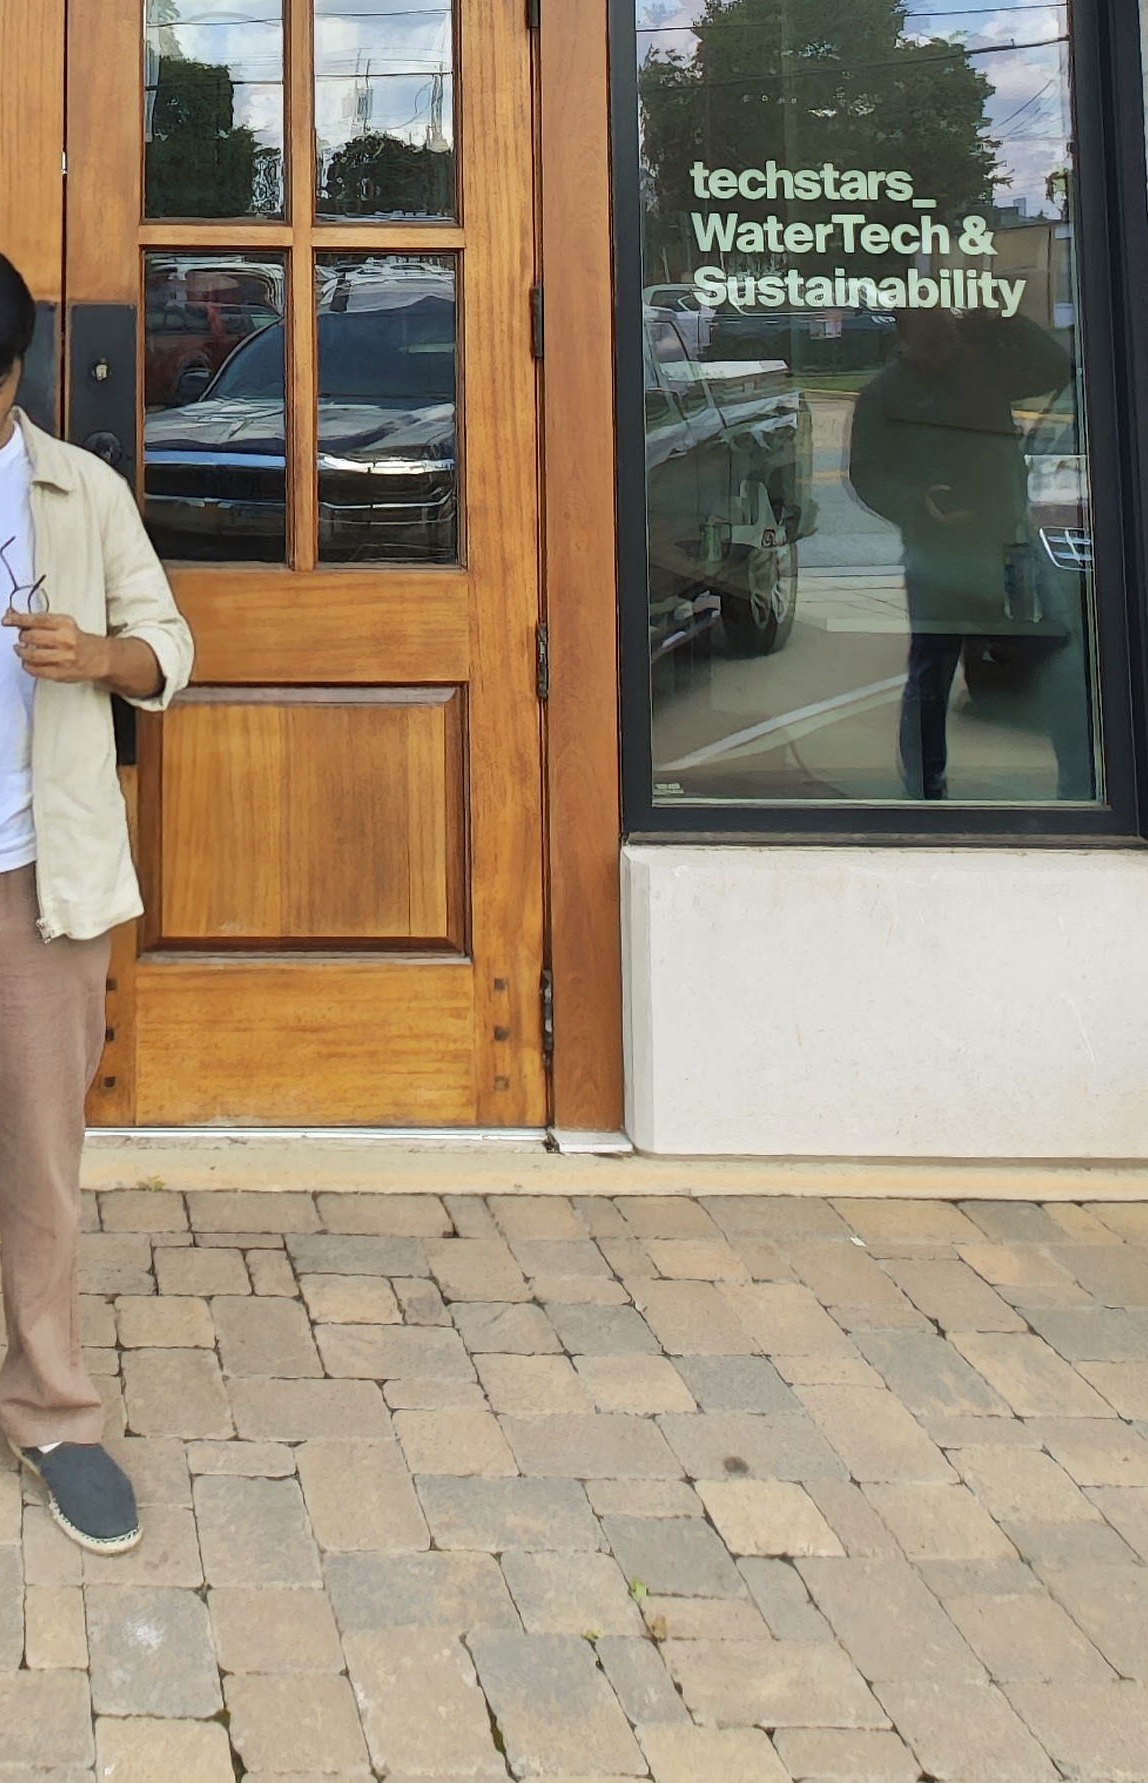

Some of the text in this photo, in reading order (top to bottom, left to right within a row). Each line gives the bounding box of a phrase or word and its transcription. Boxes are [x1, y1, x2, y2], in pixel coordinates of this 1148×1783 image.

[689, 160, 937, 208] techstars_
[690, 212, 999, 256] WaterTech &
[692, 266, 1027, 318] Sustainability
